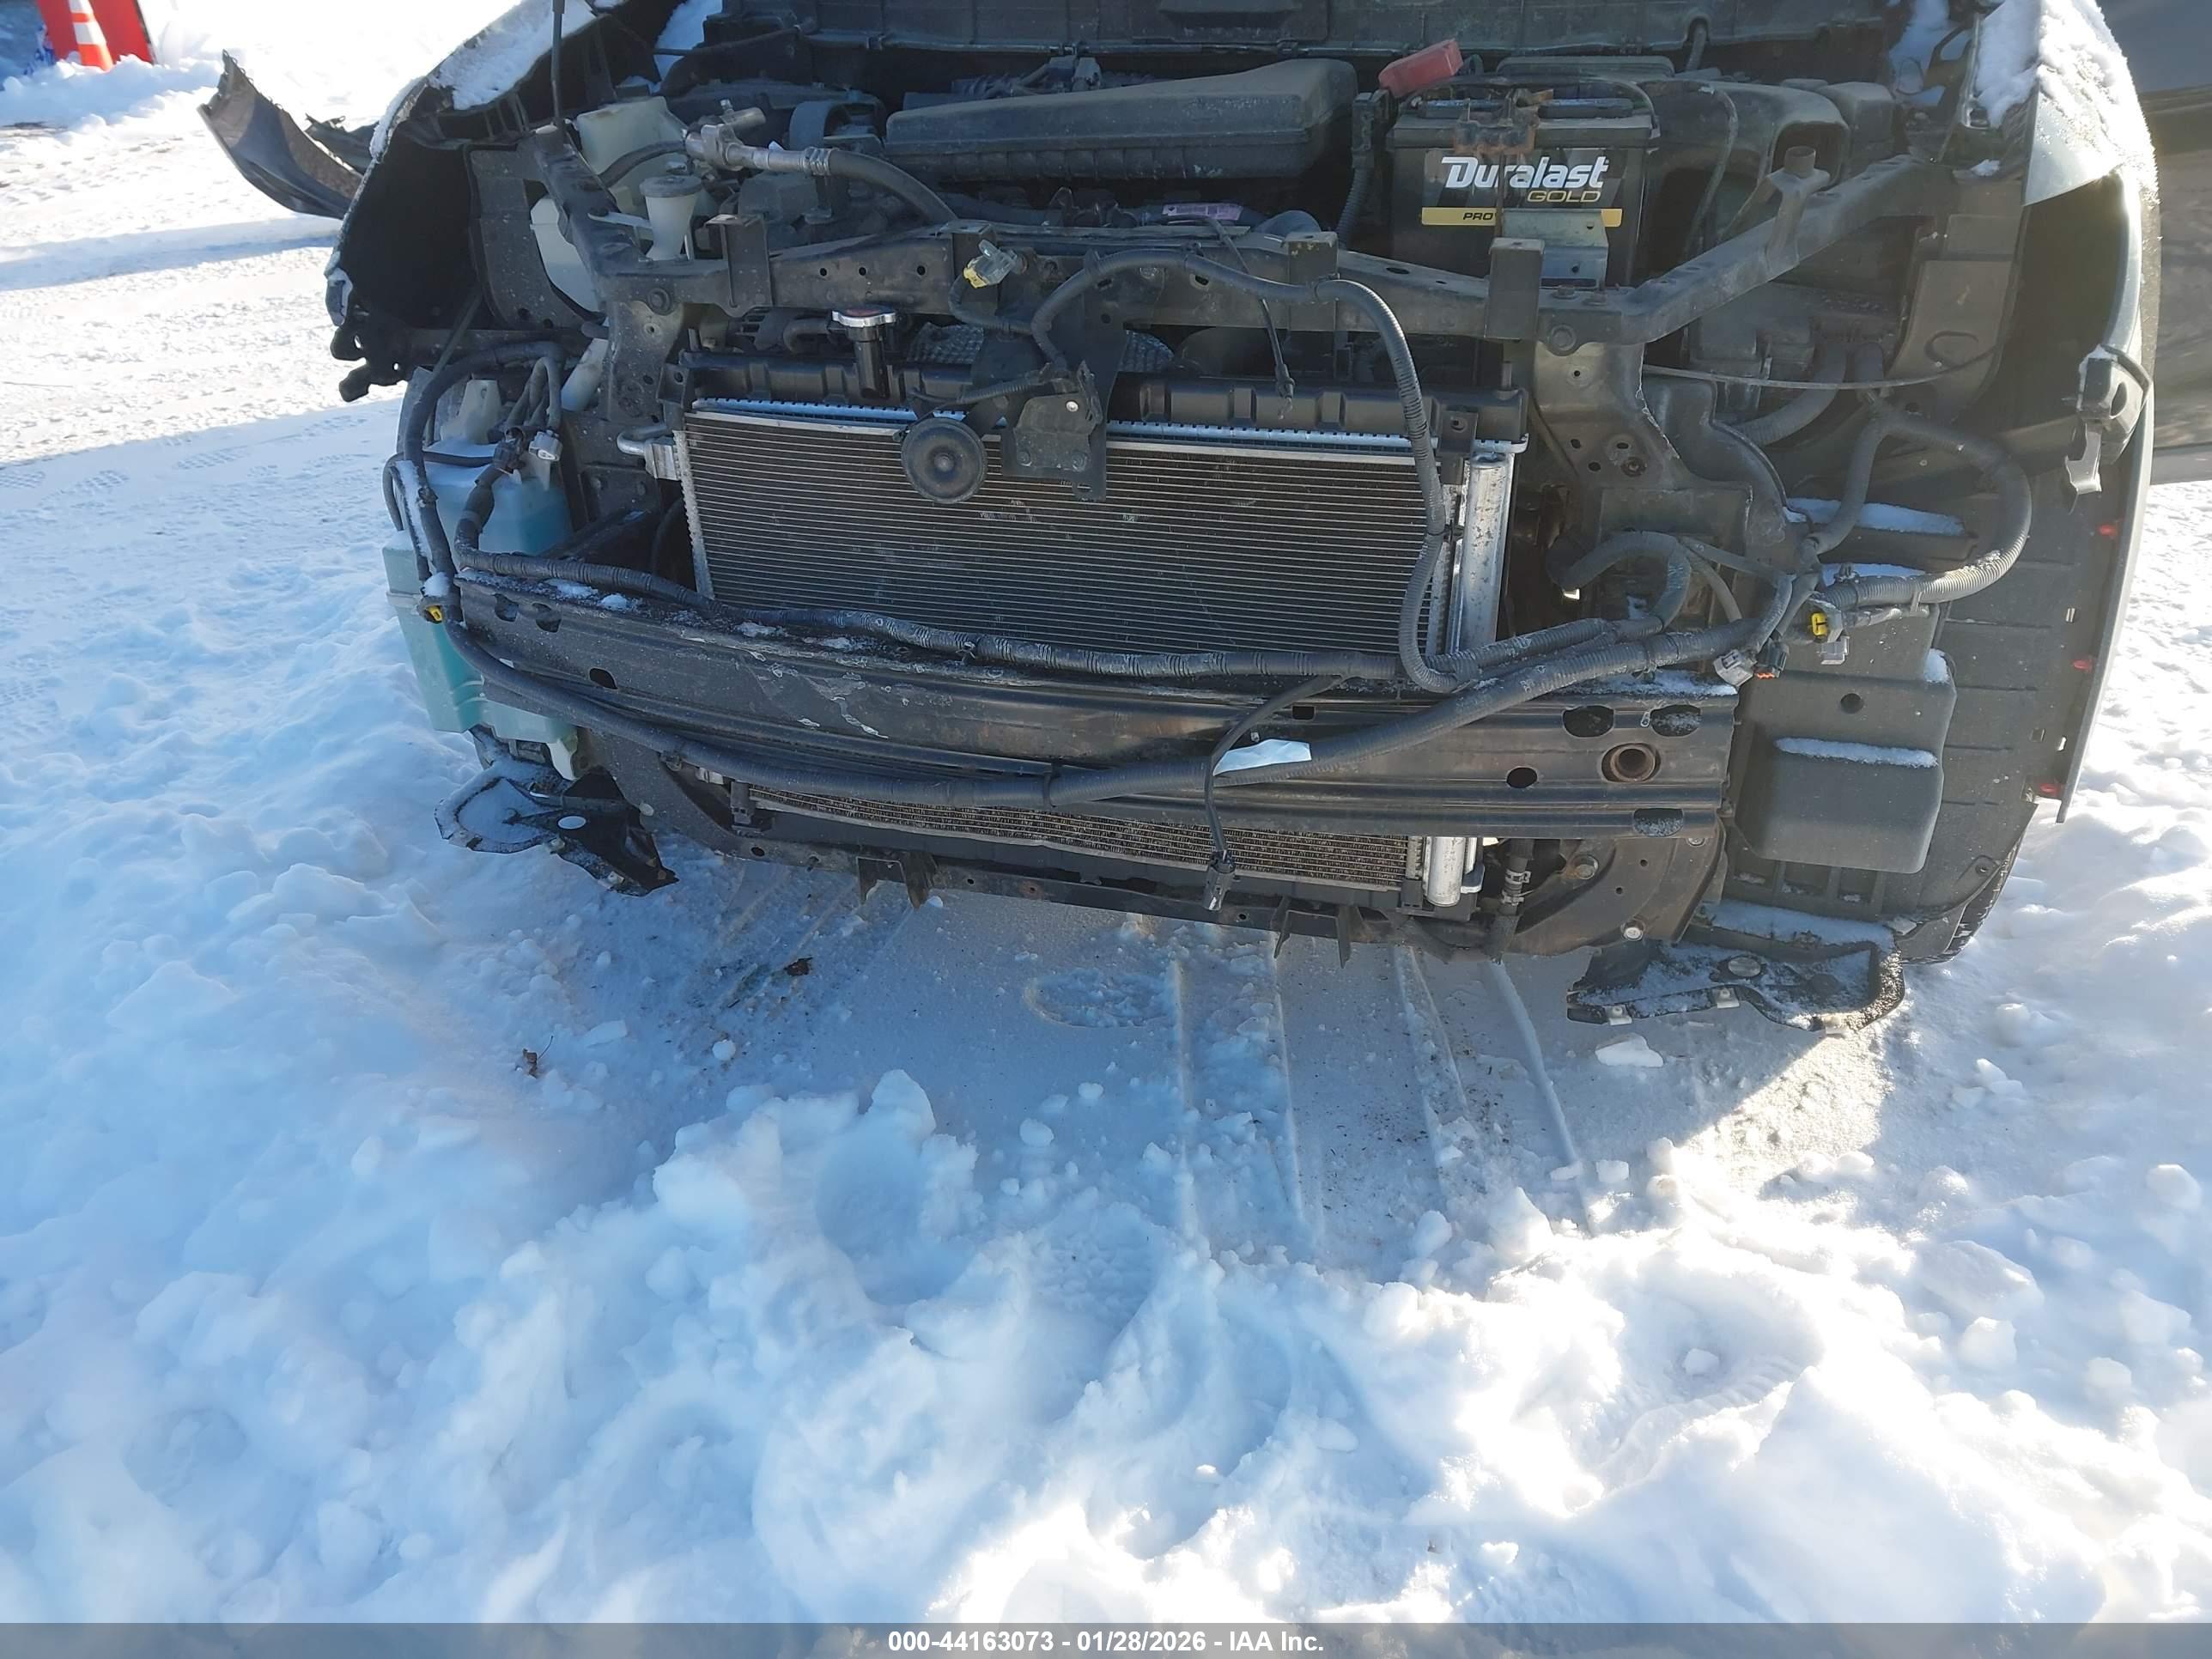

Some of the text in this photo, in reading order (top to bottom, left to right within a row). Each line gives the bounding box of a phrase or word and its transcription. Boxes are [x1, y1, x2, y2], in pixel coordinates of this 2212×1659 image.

[1441, 155, 1609, 189] Duralast
[1527, 190, 1601, 203] GOLD
[1462, 212, 1497, 221] PRO
